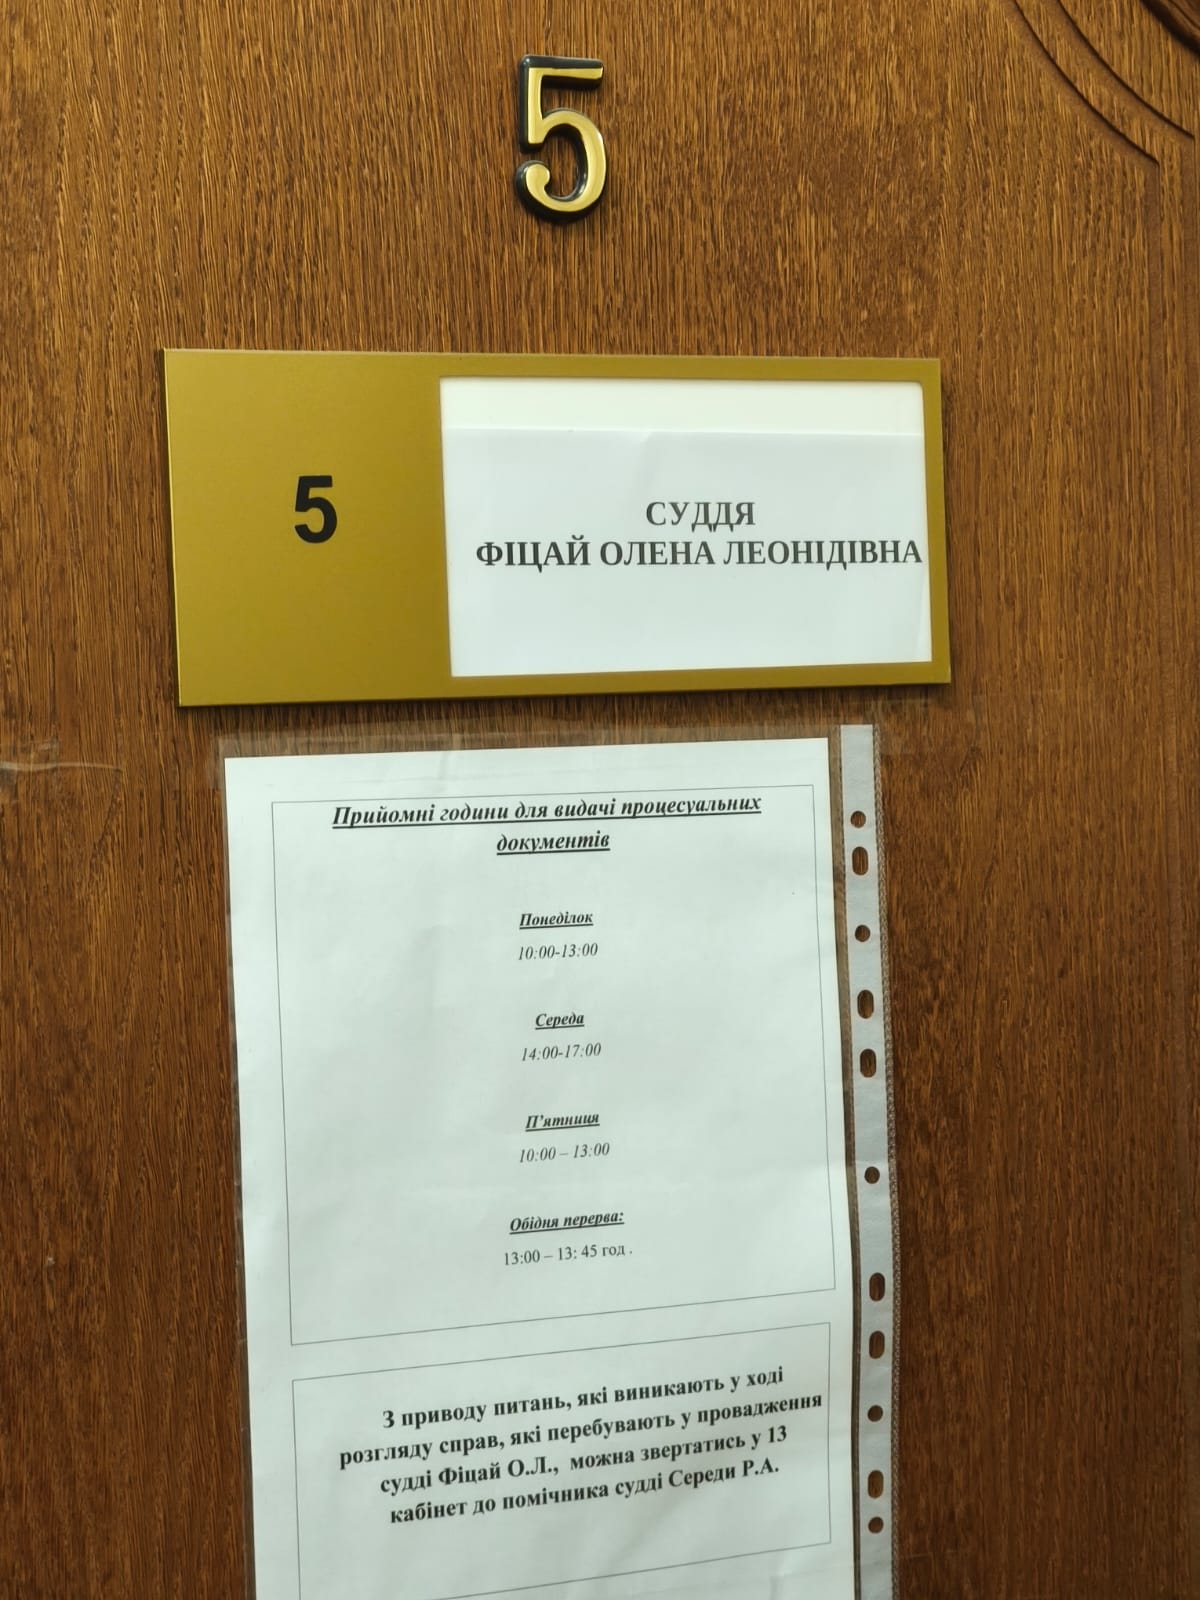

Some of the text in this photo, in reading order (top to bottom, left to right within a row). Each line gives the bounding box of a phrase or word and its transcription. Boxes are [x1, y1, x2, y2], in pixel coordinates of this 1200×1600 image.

[514, 55, 607, 218] 5
[293, 475, 337, 543] 5
[646, 502, 755, 532] СУДДЯ
[476, 535, 922, 572] ФІЦАЙ ОЛЕНА ЛЕОНІДІВНА
[332, 795, 761, 829] Прийомні години для видачі процесуальних
[496, 831, 611, 855] документів
[519, 911, 593, 929] Понеділок
[517, 942, 598, 961] 10:00-13:00
[535, 1012, 584, 1030] Середа
[521, 1043, 601, 1061] 14:00-17:00
[519, 1147, 556, 1163] 10:00
[573, 1143, 610, 1158] 13:00
[510, 1212, 624, 1234] Обідня перерва:
[504, 1250, 540, 1265] 13:00
[383, 1366, 784, 1429] З приводу питань, які виникають у ході
[339, 1395, 823, 1469] розгляду справ, які перебувають у провадження
[380, 1426, 788, 1496] судді Фіцай О.Л., можна звертатись у 13
[390, 1458, 780, 1523] кабінет до помічника судді Середи Р.А.
